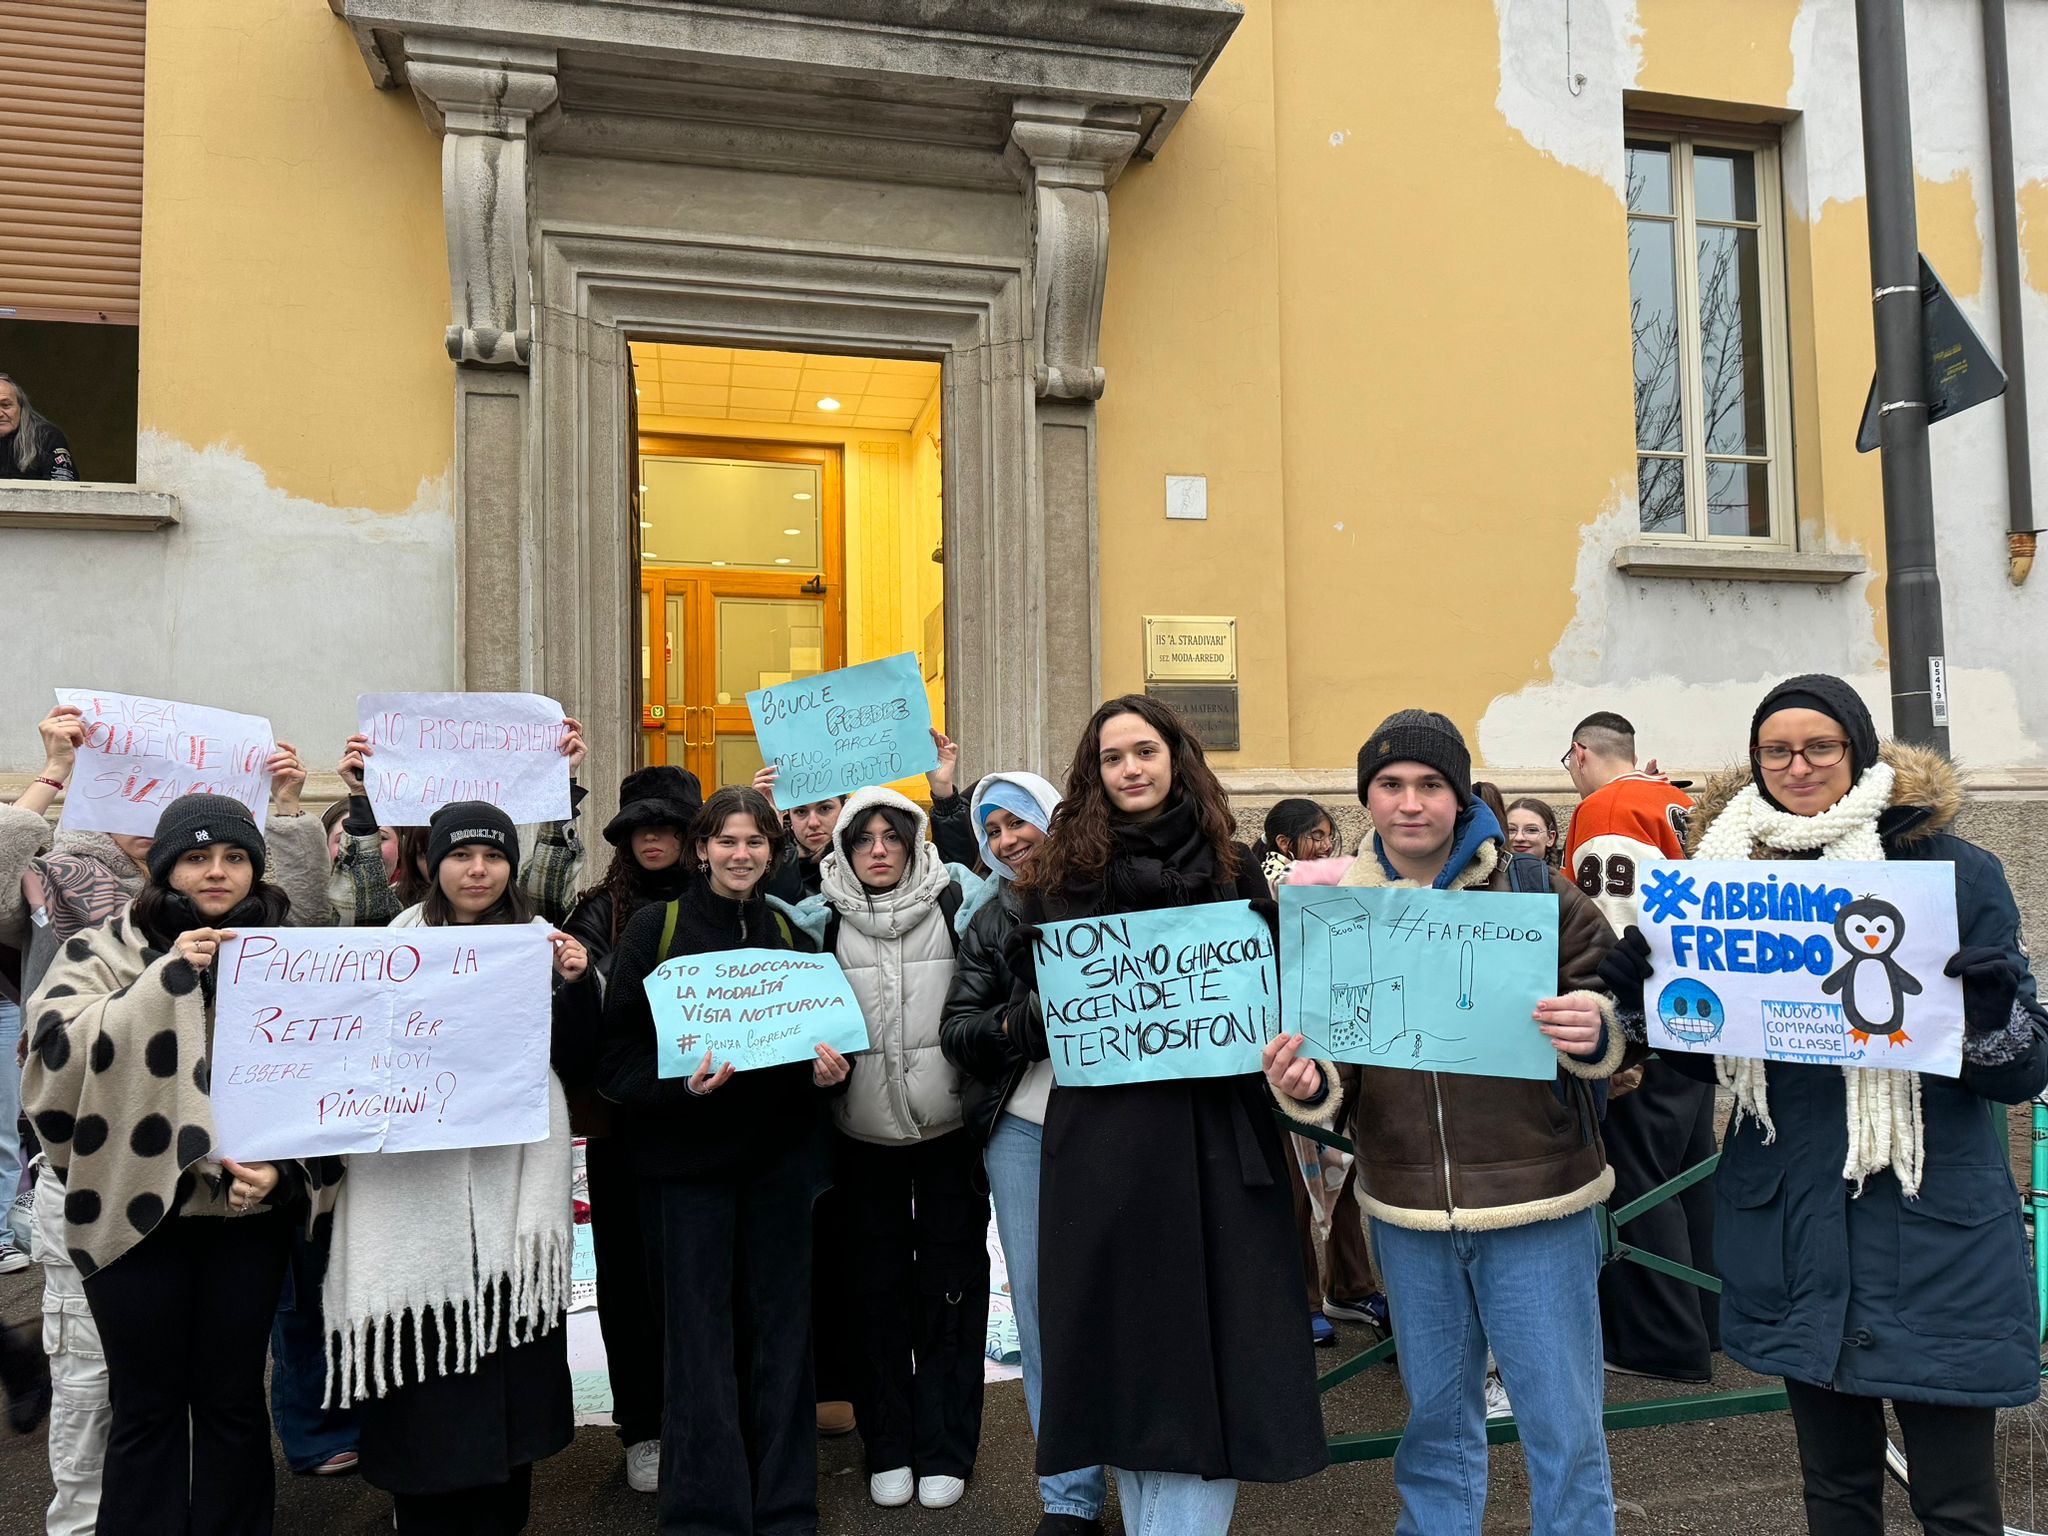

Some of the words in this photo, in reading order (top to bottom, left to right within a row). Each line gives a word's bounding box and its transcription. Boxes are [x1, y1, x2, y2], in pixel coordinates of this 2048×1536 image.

[1171, 653, 1225, 662] MODA-ARREDO
[1934, 660, 1942, 699] 05419
[761, 685, 834, 725] SCUOLE
[1190, 703, 1229, 713] MATERNA
[372, 712, 405, 746] NO
[375, 772, 410, 802] NO
[449, 828, 505, 844] BROOKLYN
[1577, 853, 1636, 898] 89
[1035, 918, 1132, 966] NON
[1331, 923, 1364, 937] Scuola
[452, 946, 478, 975] LA
[1670, 924, 1835, 976] FREDDO
[656, 964, 700, 981] STO
[1080, 943, 1171, 989] SIAMO
[676, 985, 697, 1000] LA
[1046, 967, 1231, 1028] ACCENDETE
[739, 996, 845, 1024] NOTTURNA
[1773, 1006, 1823, 1019] NUOVO
[249, 1006, 363, 1044] RETTA
[404, 1010, 445, 1037] PER
[1766, 1020, 1844, 1035] COMPAGNO
[1769, 1035, 1783, 1047] DI
[1788, 1037, 1842, 1052] CLASSE
[227, 1062, 313, 1085] ESSERE
